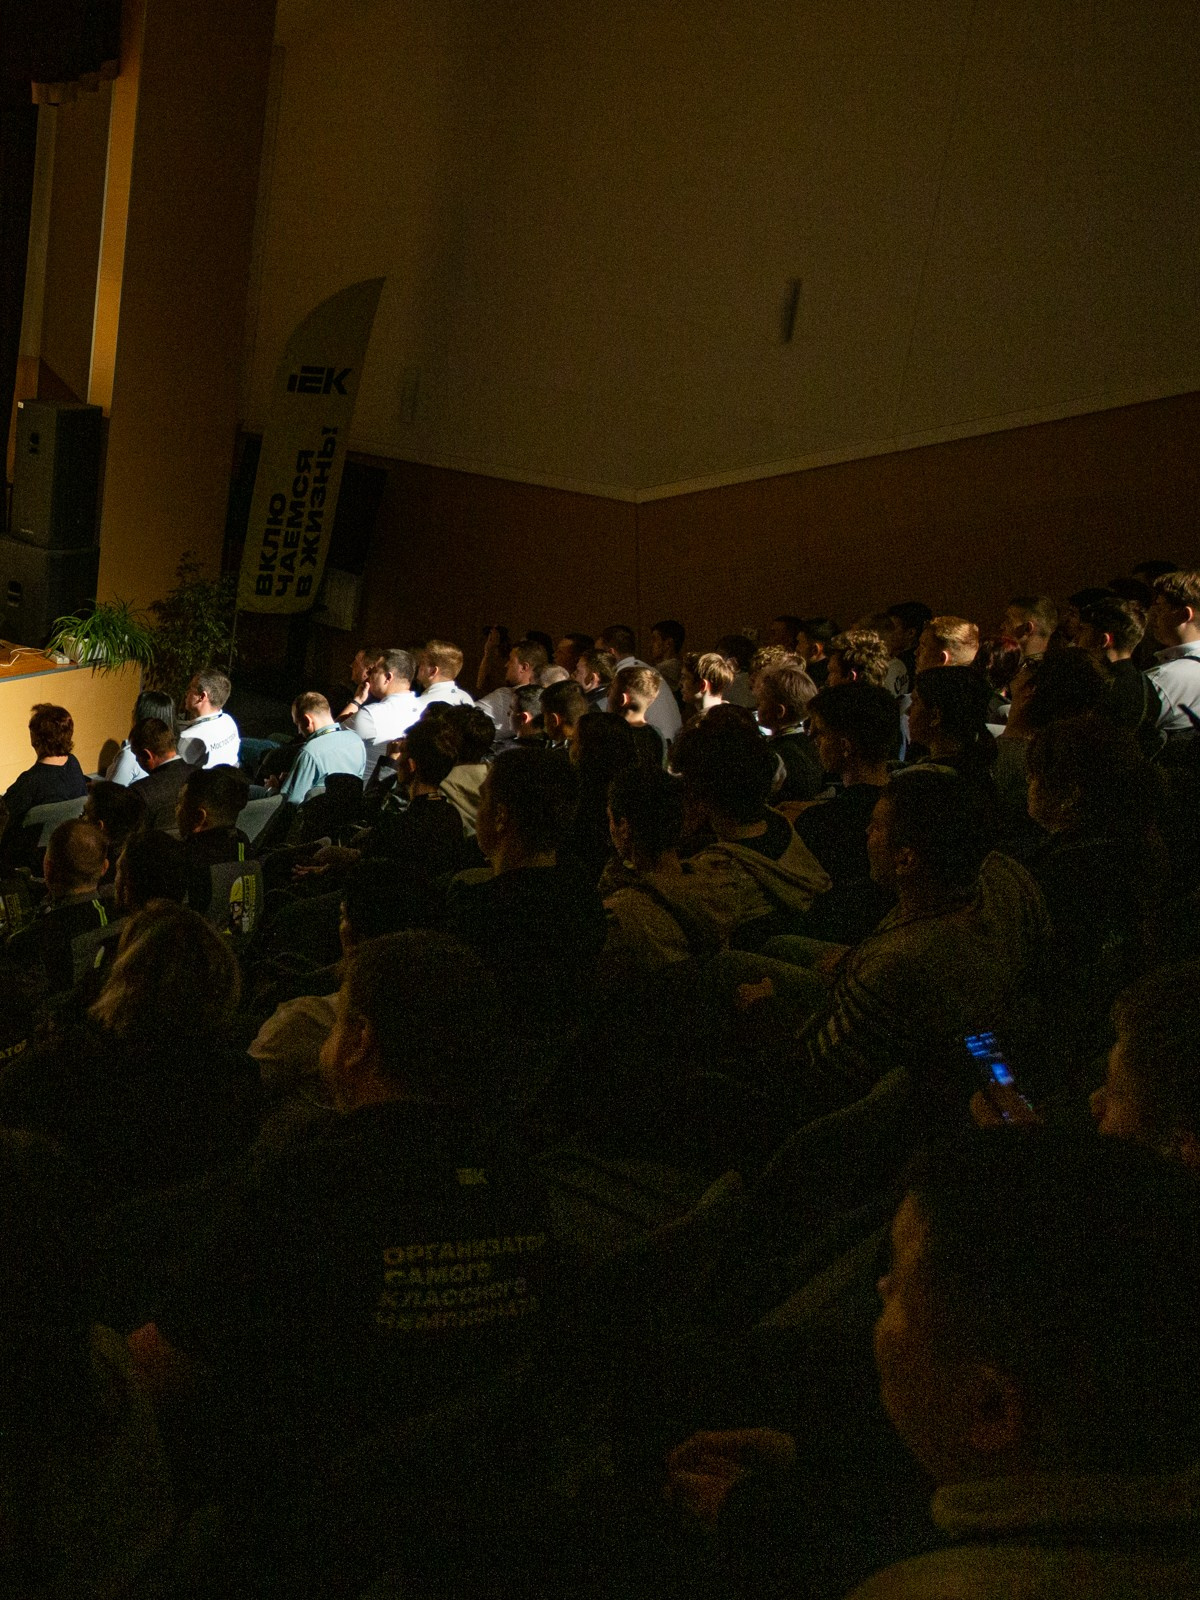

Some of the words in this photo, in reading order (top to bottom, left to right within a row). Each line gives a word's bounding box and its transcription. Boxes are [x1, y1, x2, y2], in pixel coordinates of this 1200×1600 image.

[255, 492, 287, 597] ВКЛЮ
[275, 450, 315, 598] ЧАЕМСЯ
[300, 426, 338, 568] ЖИЗНЬ!
[295, 574, 313, 598] В
